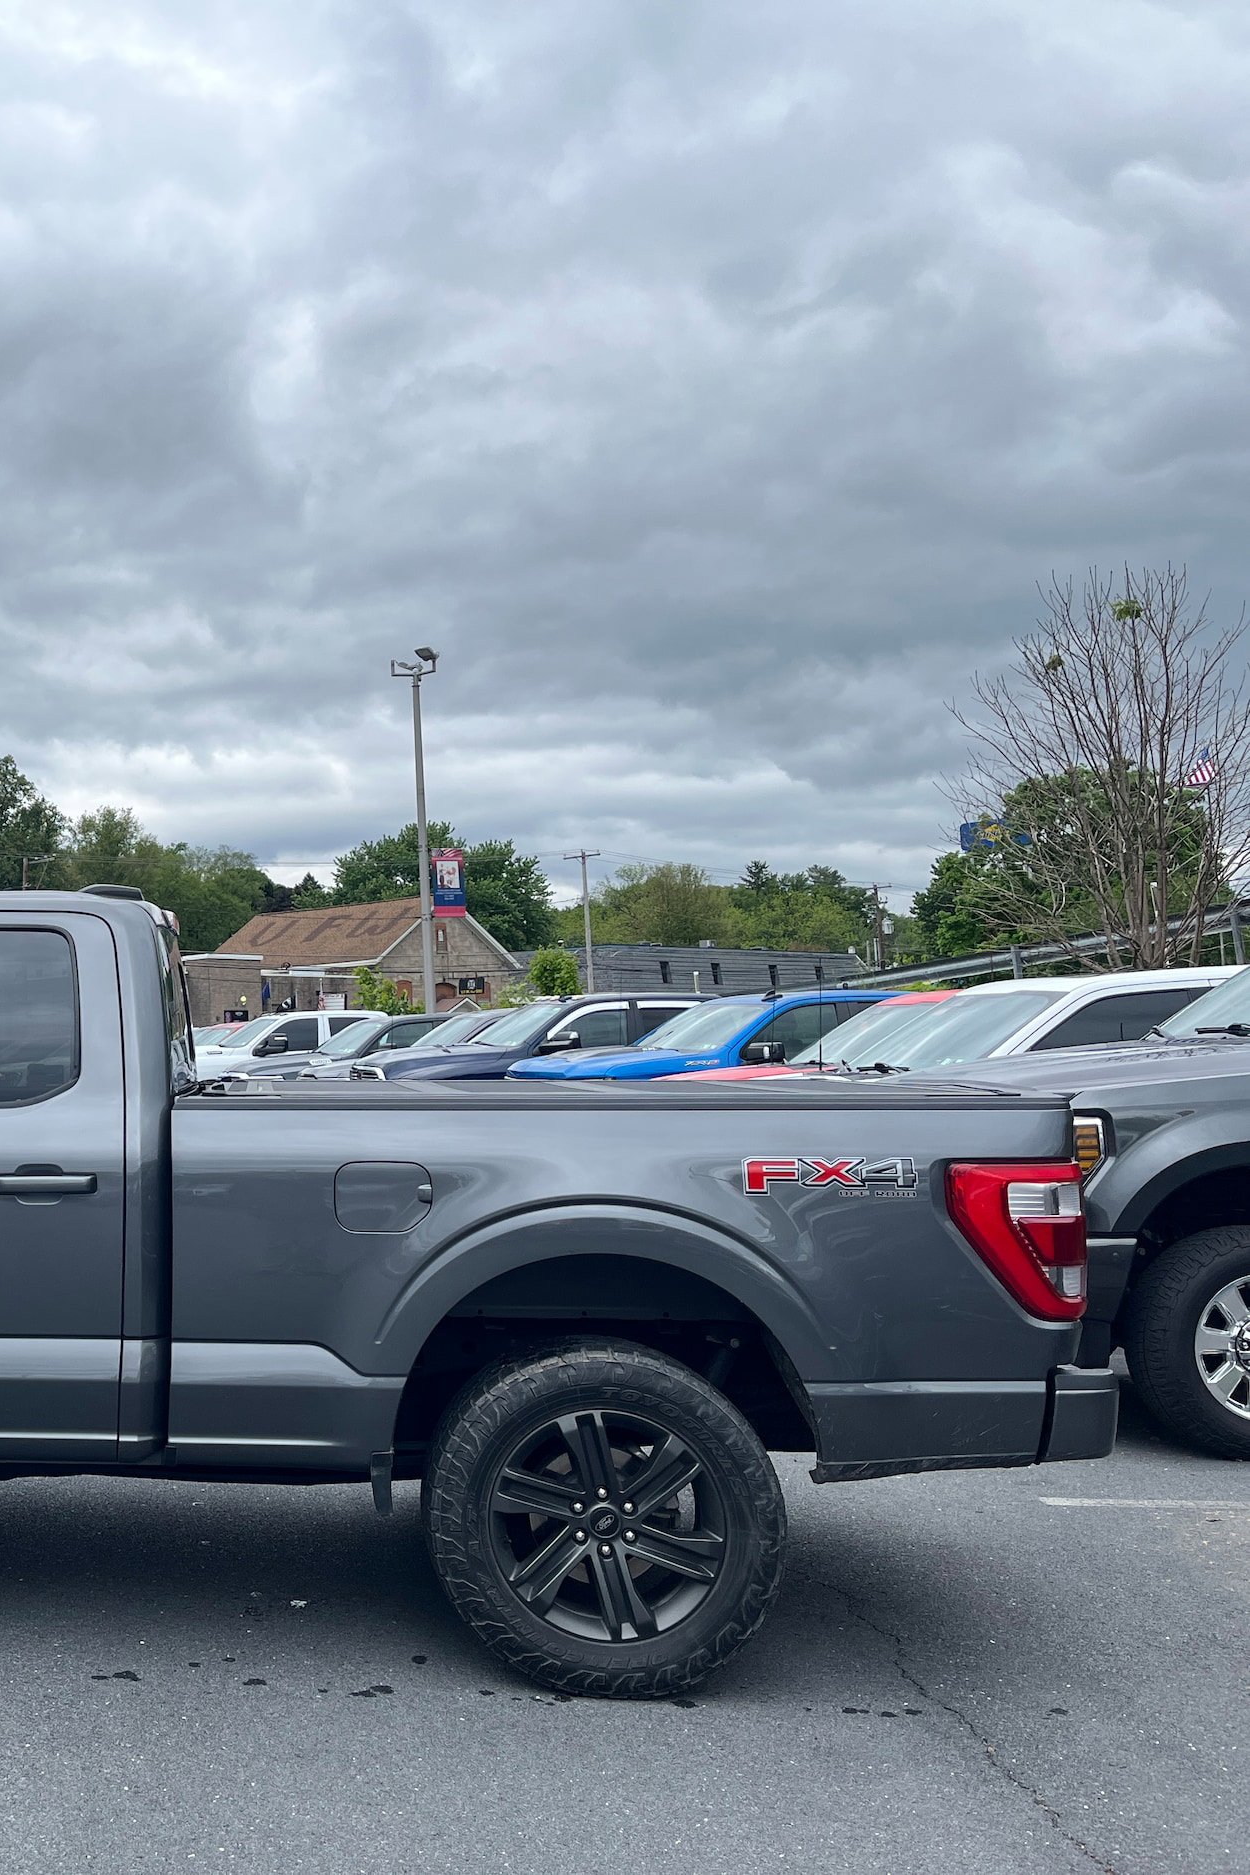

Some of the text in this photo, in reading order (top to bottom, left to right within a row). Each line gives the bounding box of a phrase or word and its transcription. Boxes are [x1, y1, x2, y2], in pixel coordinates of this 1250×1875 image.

[741, 1157, 918, 1196] FX4
[839, 1190, 917, 1198] OFF ROAD
[601, 1385, 750, 1498] TOYO TIRES
